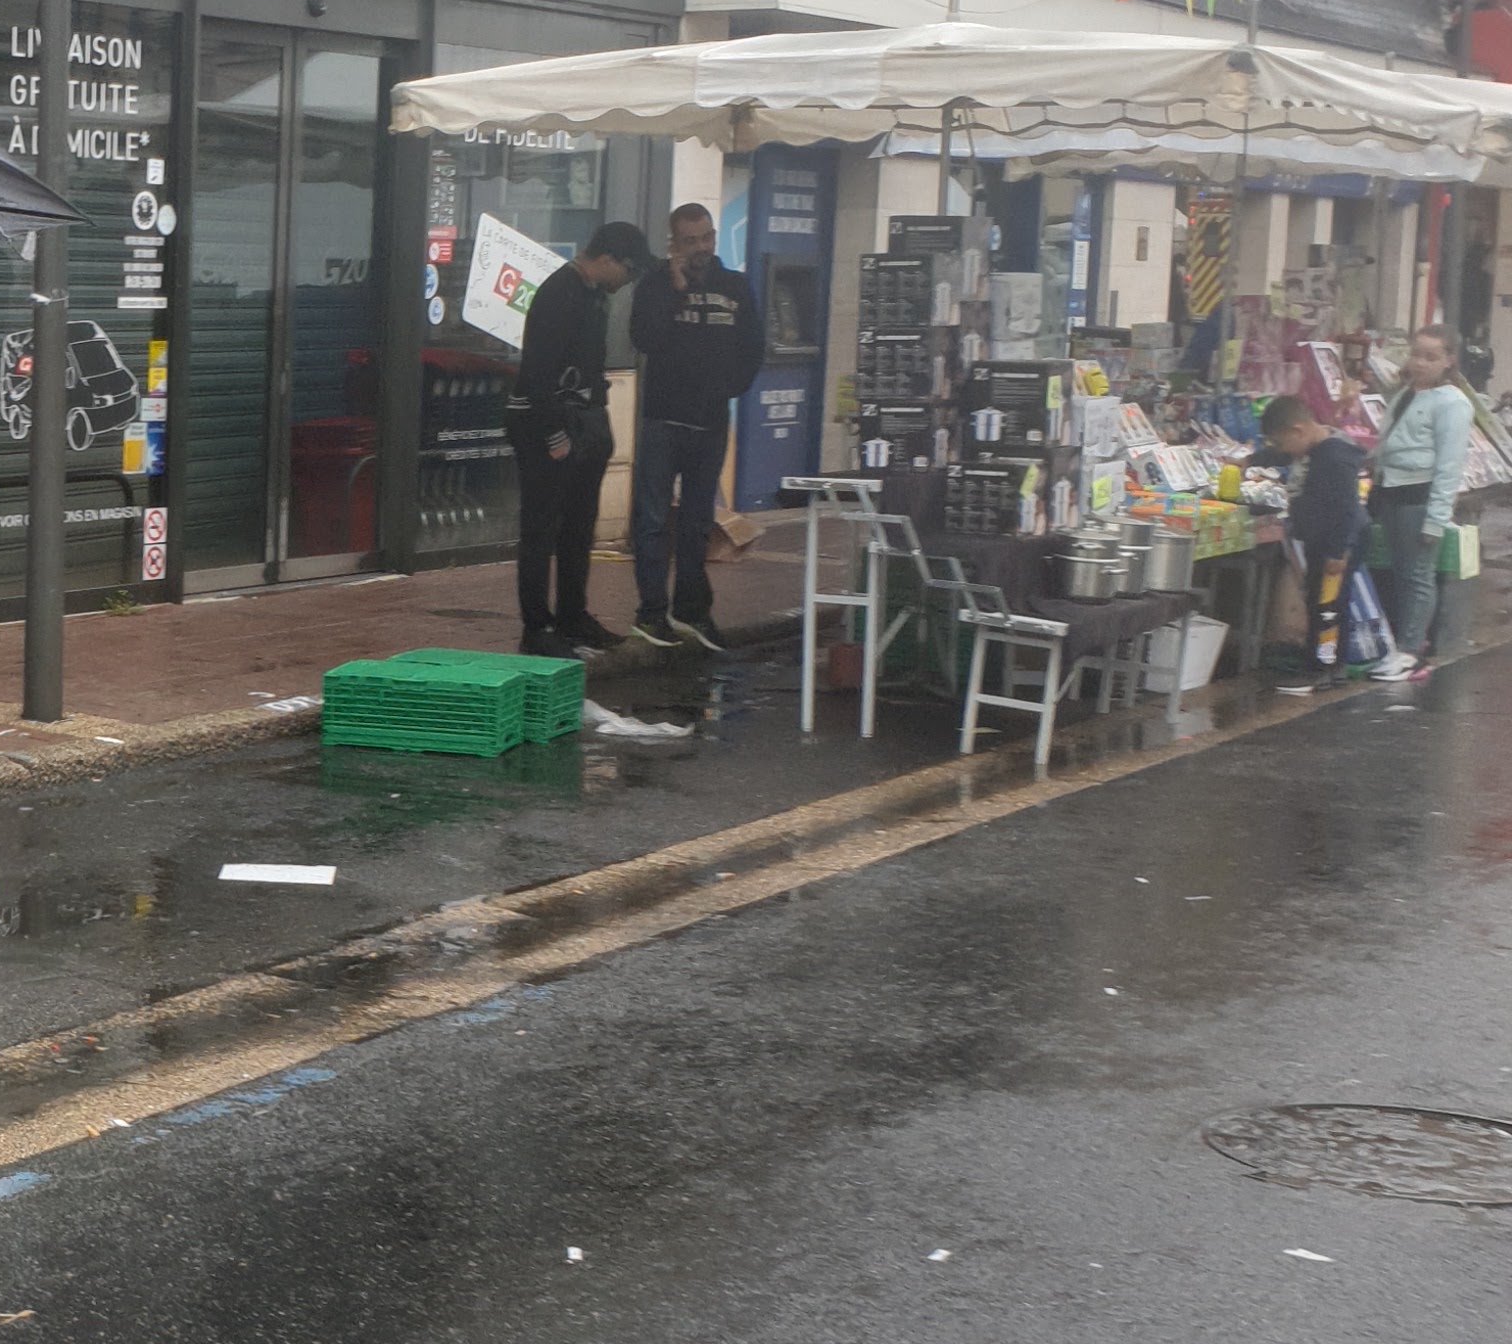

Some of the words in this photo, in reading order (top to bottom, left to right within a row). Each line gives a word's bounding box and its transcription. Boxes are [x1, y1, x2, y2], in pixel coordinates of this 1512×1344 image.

[11, 26, 142, 69] LIAISON
[10, 74, 139, 115] GTUITE
[8, 115, 27, 154] À
[31, 124, 151, 162] MICILE
